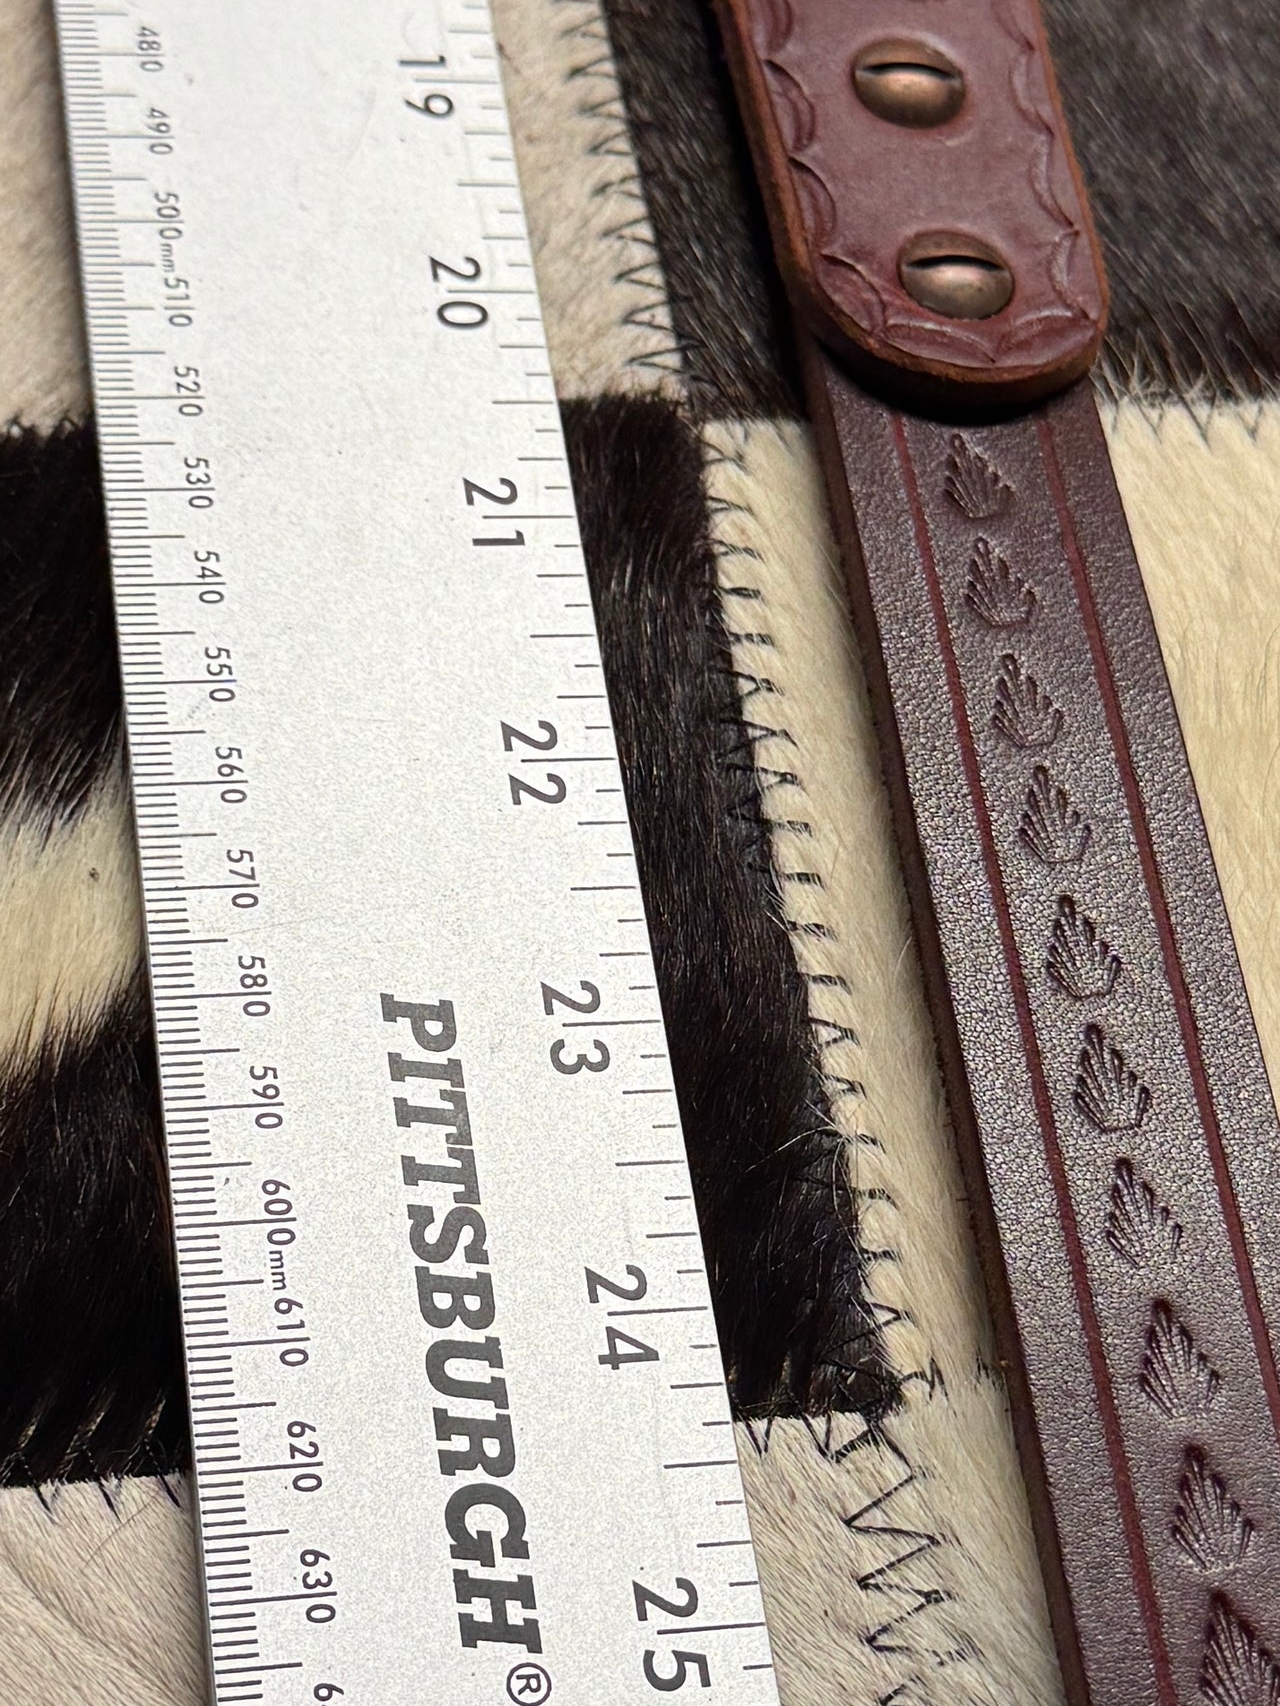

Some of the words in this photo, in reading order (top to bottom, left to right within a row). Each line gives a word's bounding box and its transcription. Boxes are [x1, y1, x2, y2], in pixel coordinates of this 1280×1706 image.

[138, 28, 161, 72] 480
[148, 109, 174, 154] 490
[164, 280, 190, 327] 510
[174, 366, 202, 416] 520
[184, 458, 212, 508] 530
[195, 551, 224, 604] 540
[206, 646, 235, 702] 550
[215, 747, 246, 803] 560
[227, 850, 259, 908] 570
[400, 55, 454, 120] 19
[430, 256, 487, 330] 20
[464, 479, 524, 546] 21
[502, 721, 566, 805] 22
[540, 982, 609, 1074] 23
[585, 1265, 659, 1370] 24
[633, 1579, 712, 1692] 25
[239, 955, 270, 1017] 580
[250, 1066, 281, 1129] 590
[275, 1298, 307, 1366] 610
[379, 993, 543, 1655] PITTSBURGH
[288, 1421, 321, 1491] 620
[300, 1550, 335, 1623] 630
